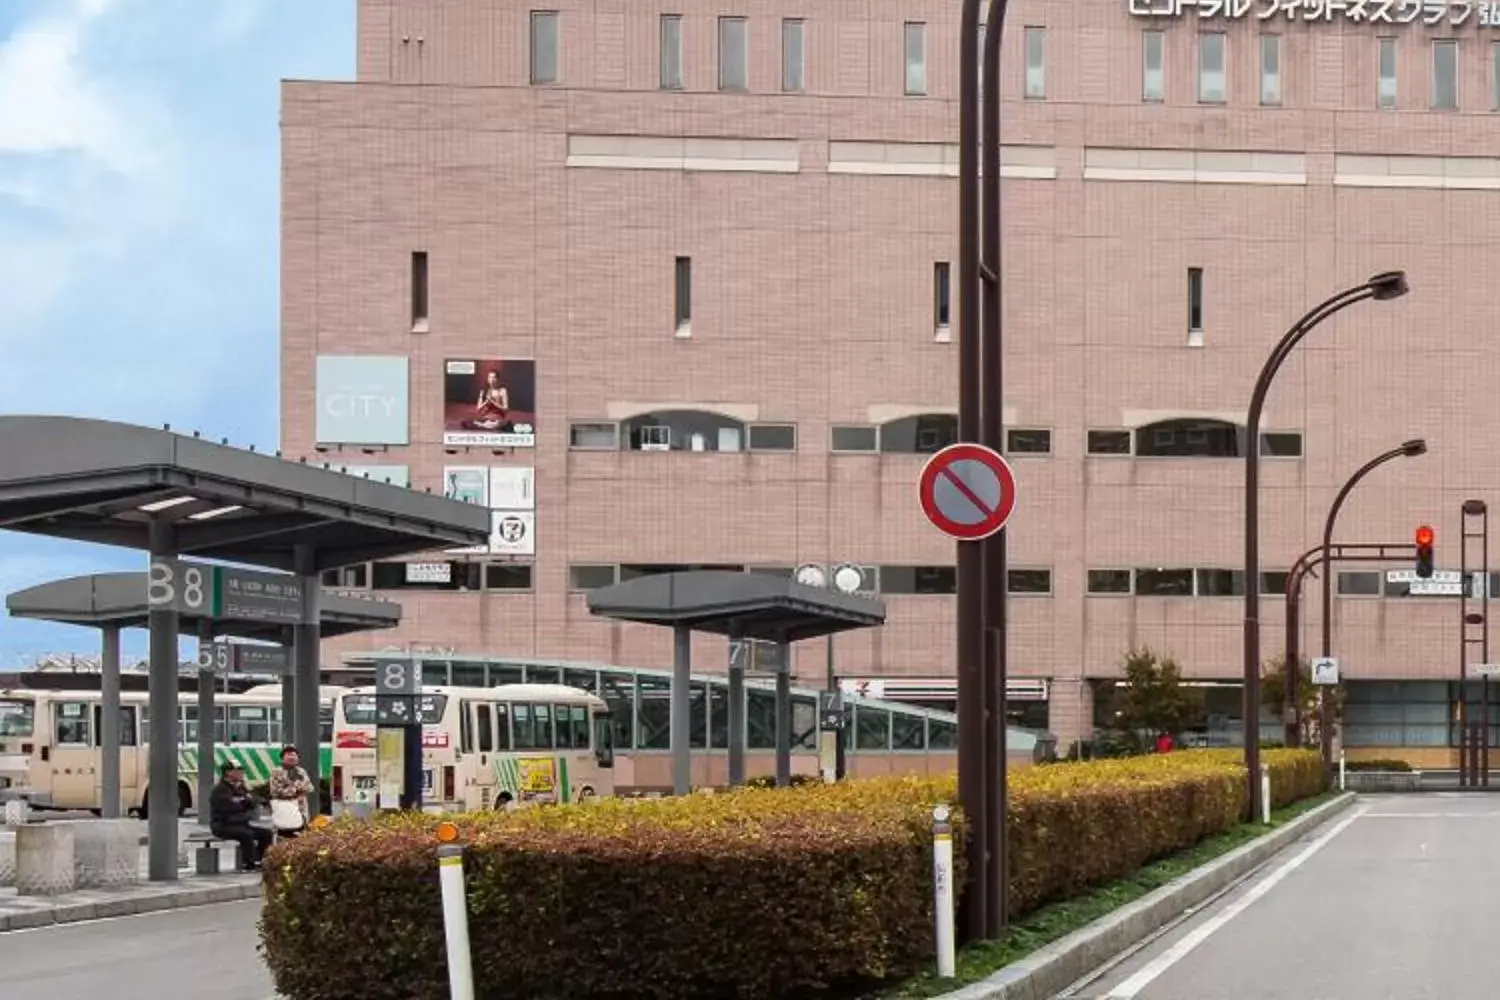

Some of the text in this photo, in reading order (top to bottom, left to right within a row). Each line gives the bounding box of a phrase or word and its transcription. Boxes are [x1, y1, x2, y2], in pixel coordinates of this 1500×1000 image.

[325, 393, 396, 417] CITY
[184, 567, 203, 608] 8
[384, 663, 405, 689] 8
